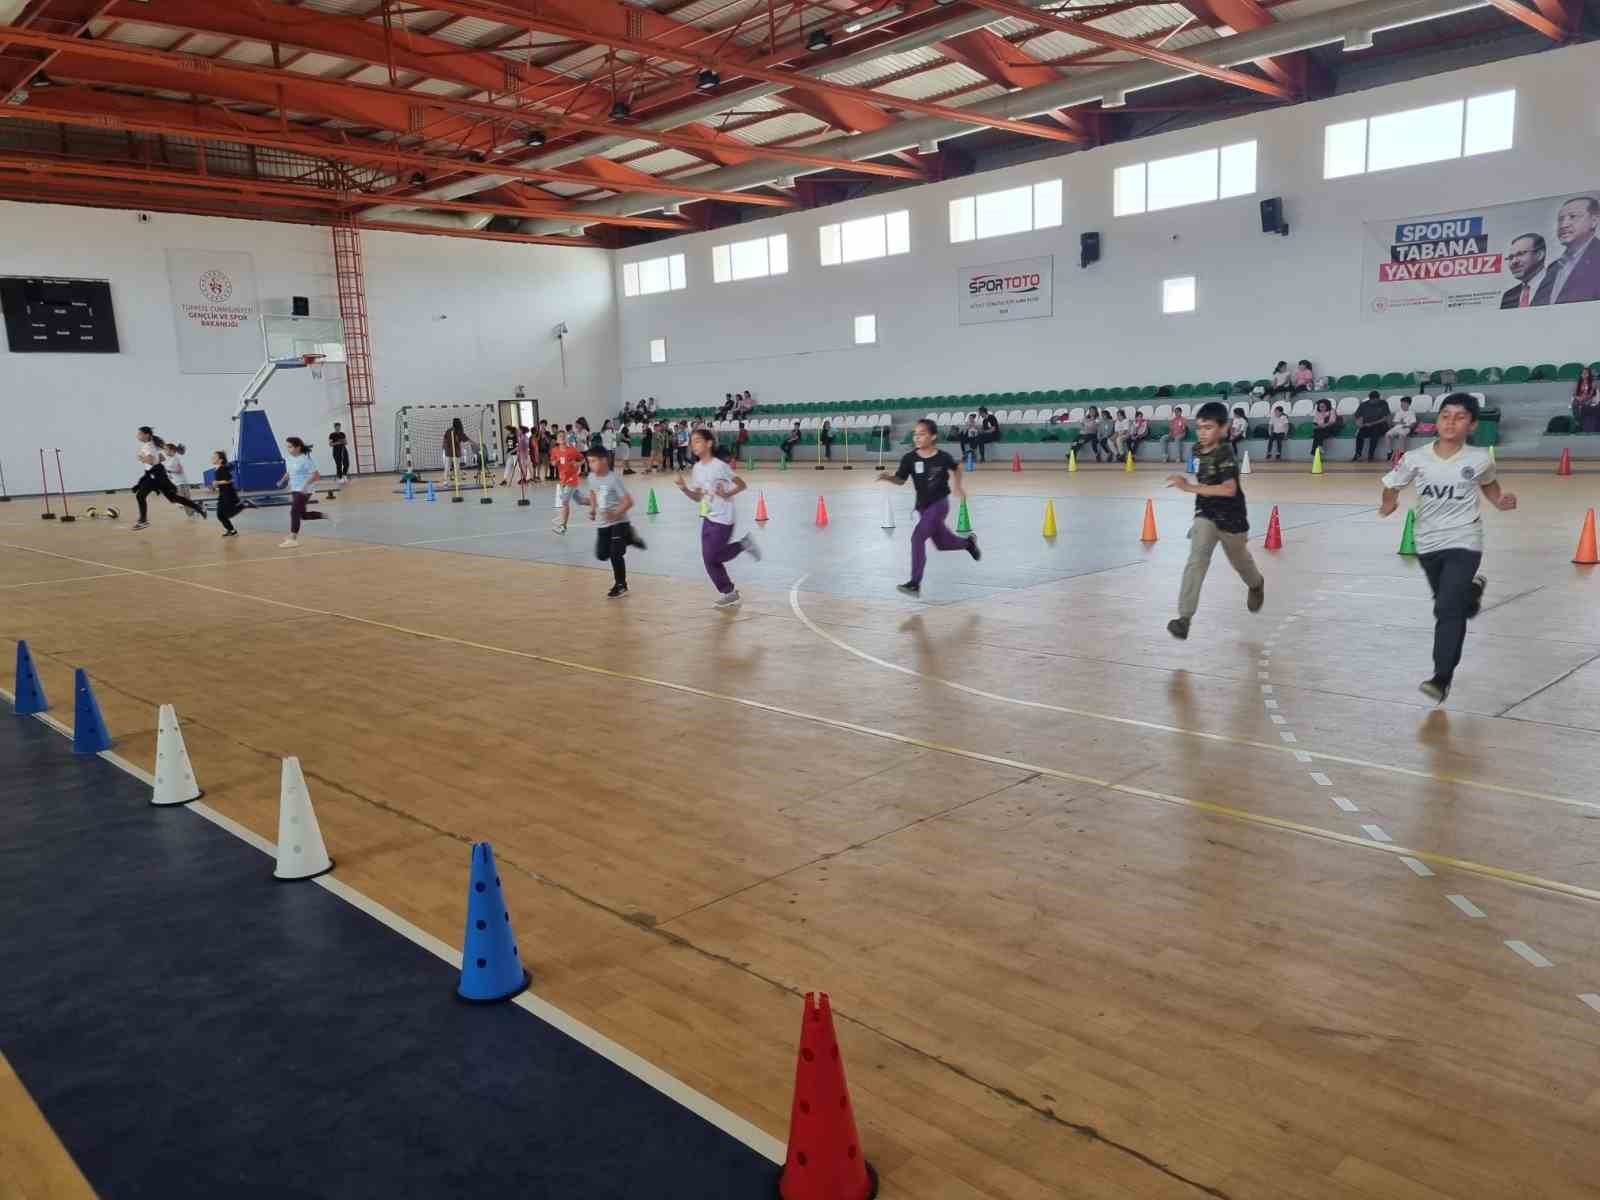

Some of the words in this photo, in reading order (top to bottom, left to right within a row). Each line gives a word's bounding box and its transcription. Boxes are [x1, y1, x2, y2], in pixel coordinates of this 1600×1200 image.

[1401, 219, 1472, 242] SPORU
[1396, 237, 1479, 262] TABANA
[1384, 256, 1497, 281] YAYIYORUZ
